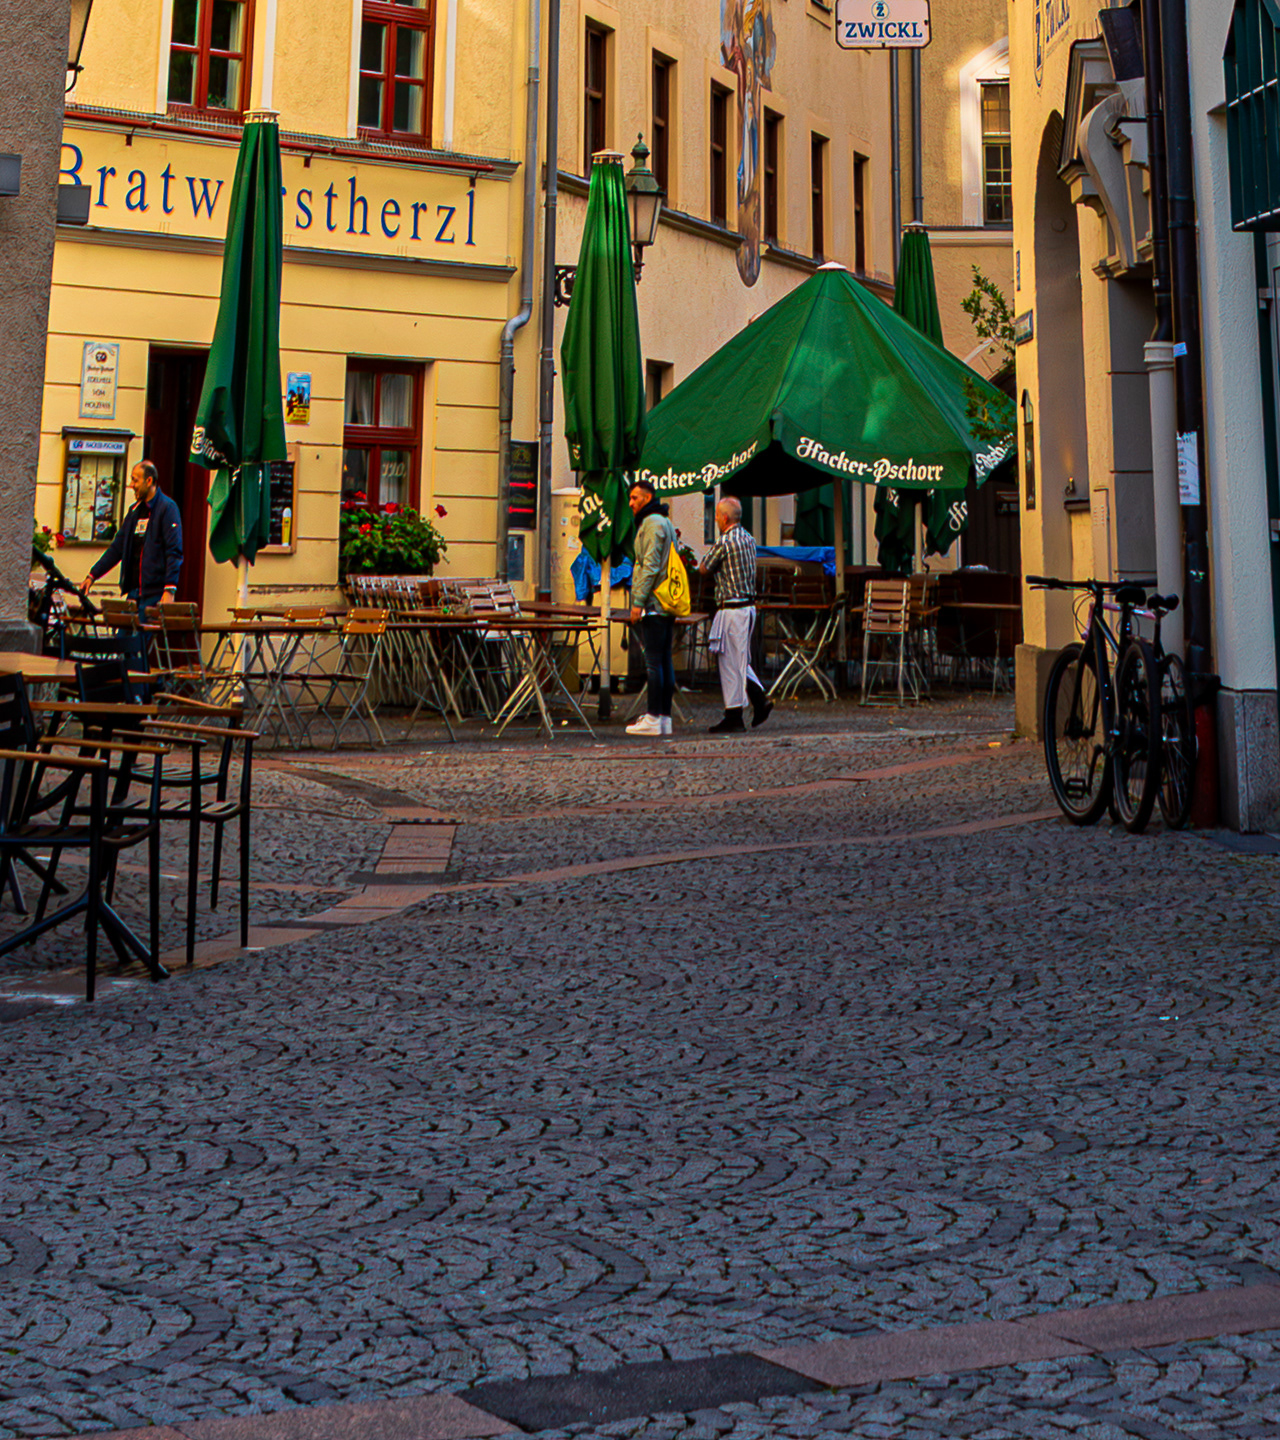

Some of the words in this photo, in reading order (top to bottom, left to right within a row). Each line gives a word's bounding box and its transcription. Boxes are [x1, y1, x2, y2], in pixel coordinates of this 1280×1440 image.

[845, 22, 923, 38] ZWICKL
[59, 143, 477, 247] ratwstherzl
[796, 436, 944, 483] Hacker-Pschorr
